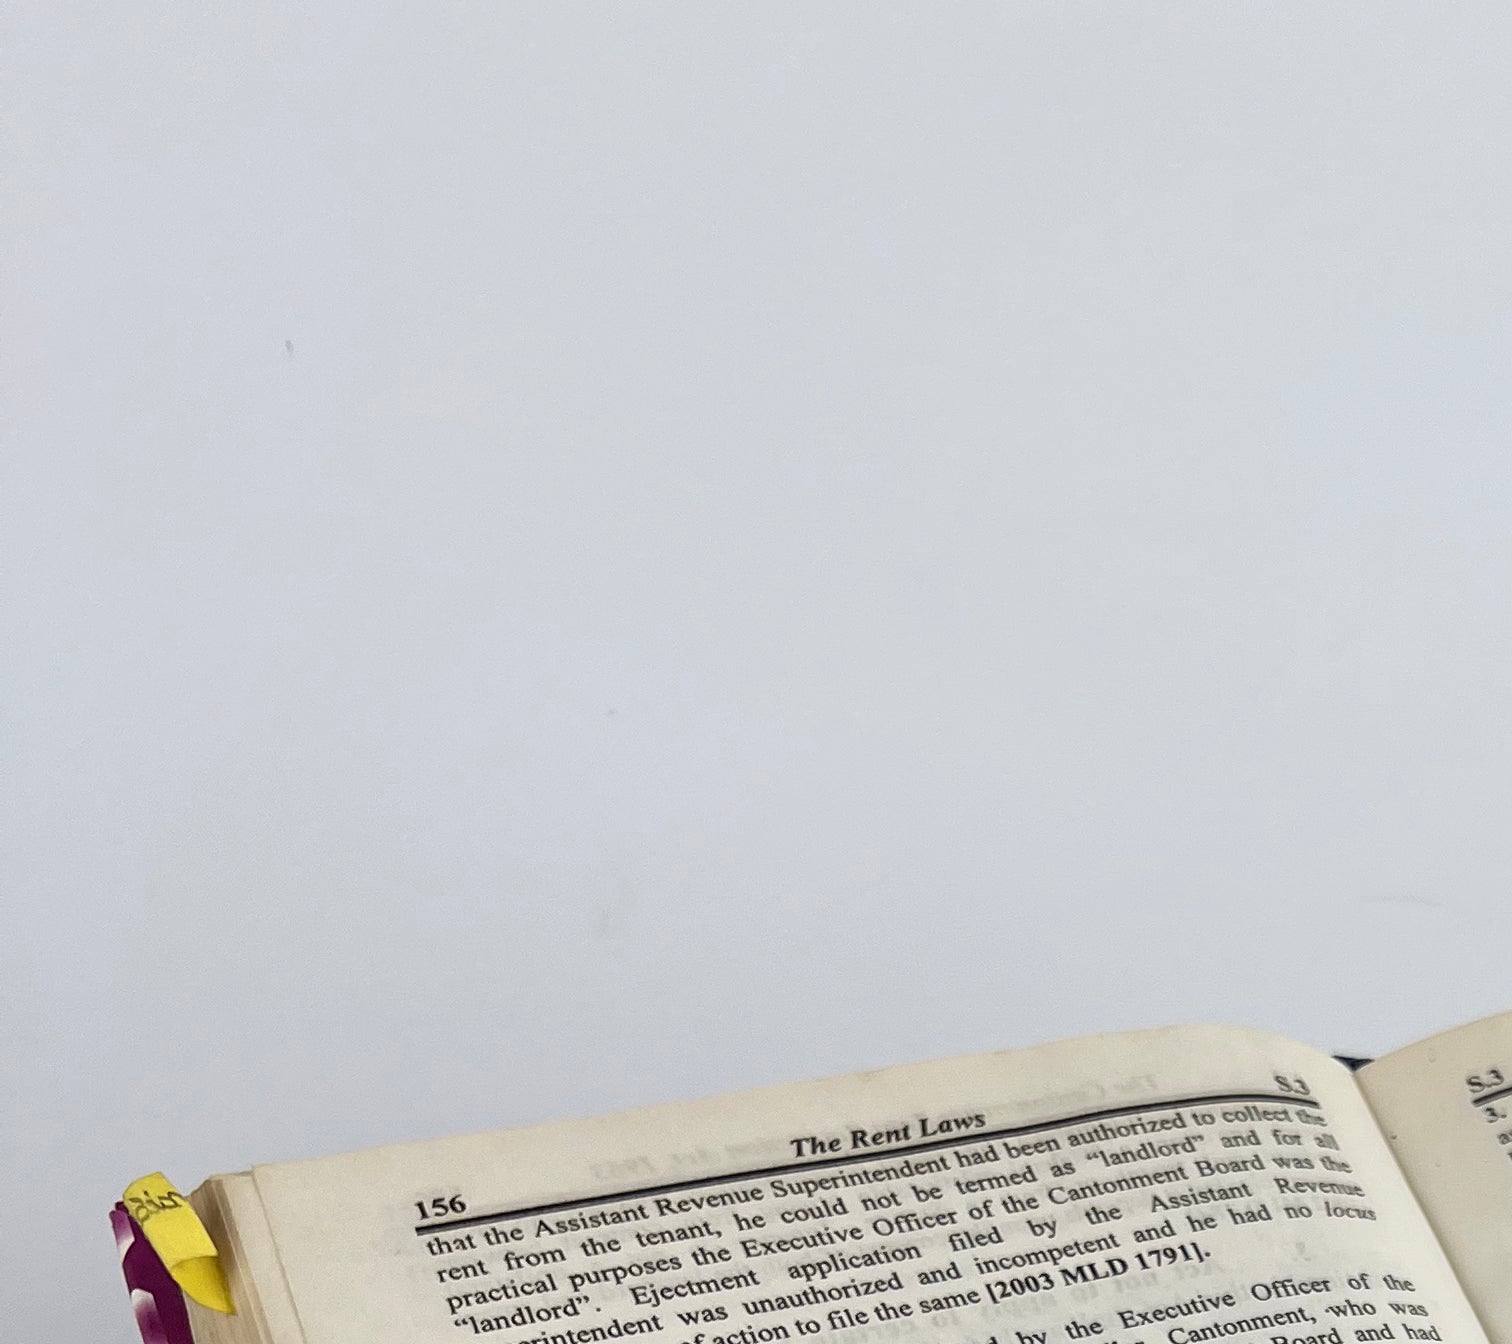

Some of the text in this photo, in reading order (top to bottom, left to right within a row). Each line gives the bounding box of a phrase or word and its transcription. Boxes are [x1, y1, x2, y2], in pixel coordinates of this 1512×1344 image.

[1273, 1074, 1311, 1096] S.3
[1466, 1069, 1504, 1093] S.3
[789, 1112, 987, 1158] The Rent Laws
[415, 1194, 467, 1221] 156
[794, 1319, 821, 1336] to
[826, 1308, 870, 1330] file
[872, 1301, 914, 1322] the
[918, 1290, 981, 1314] same
[984, 1272, 1055, 1305] [2003
[1058, 1257, 1129, 1287] MLD
[1134, 1241, 1211, 1271] 1791].
